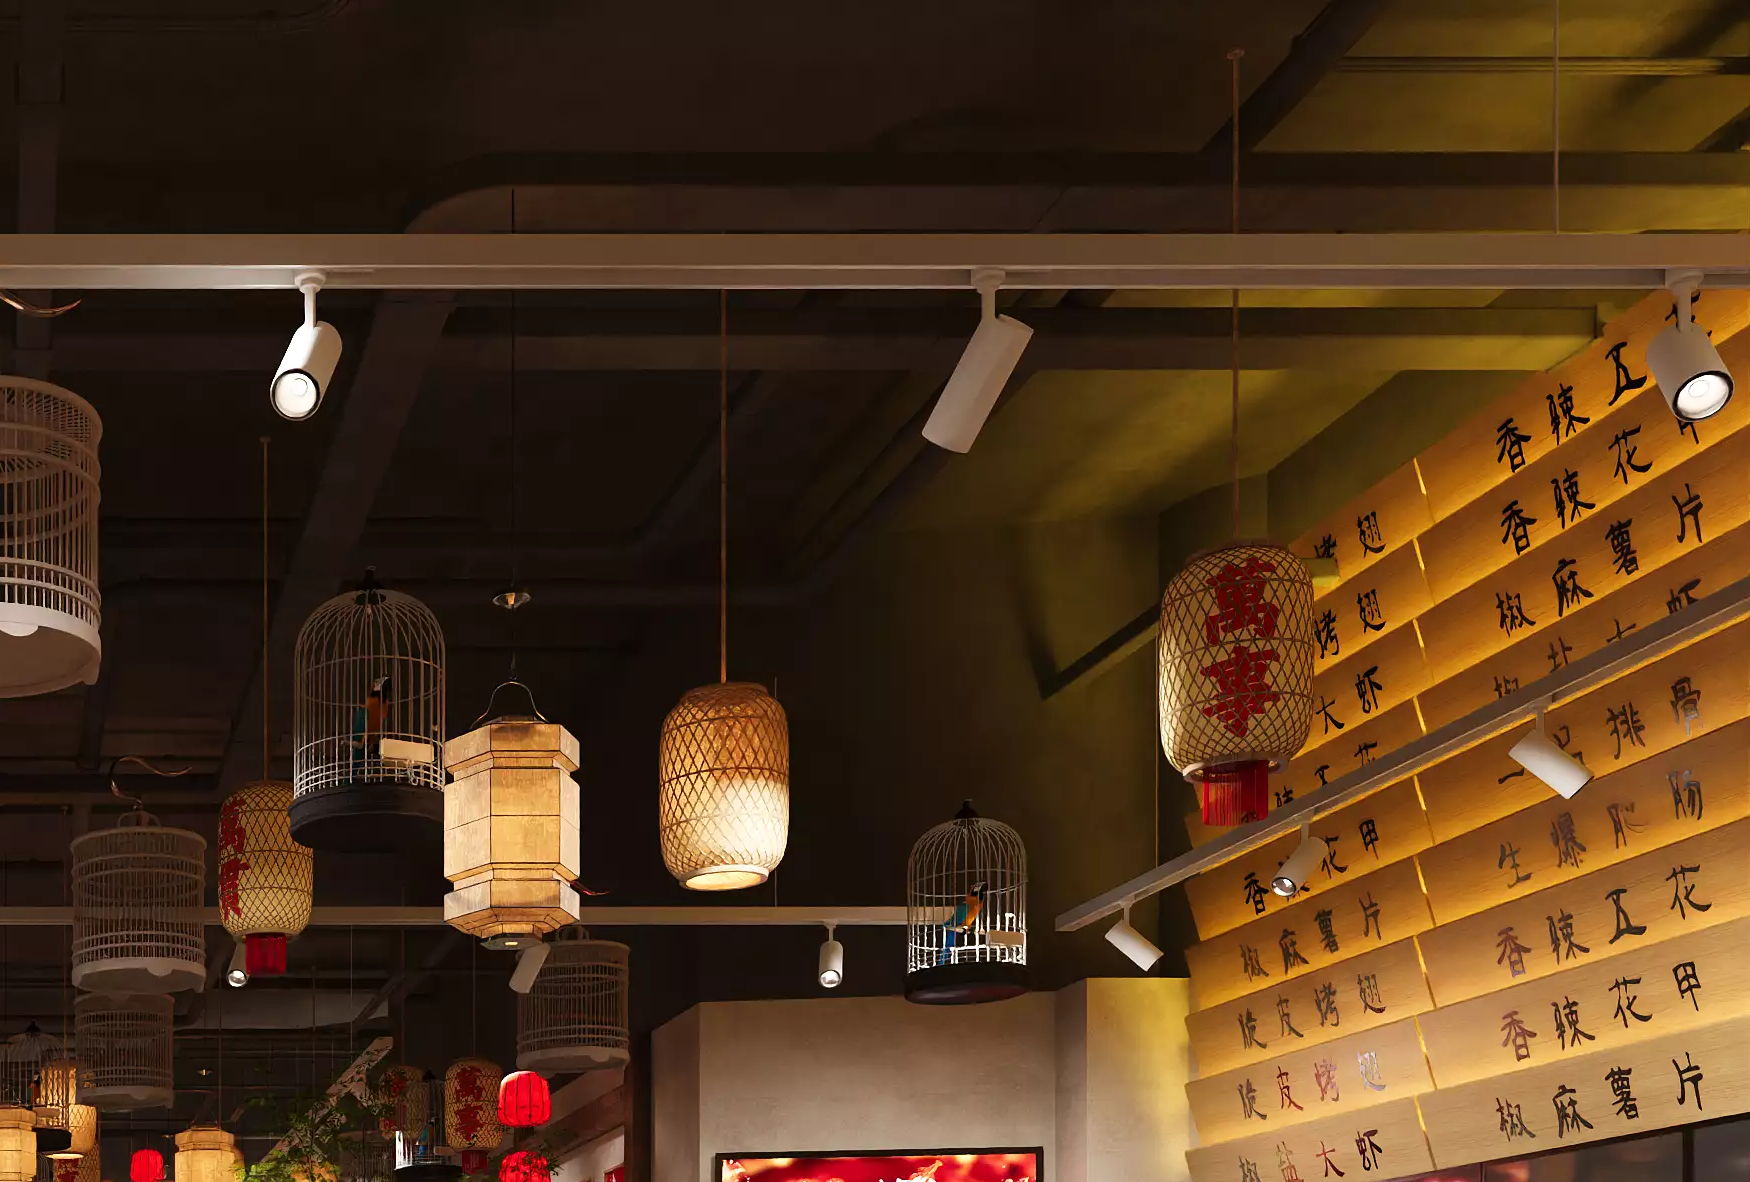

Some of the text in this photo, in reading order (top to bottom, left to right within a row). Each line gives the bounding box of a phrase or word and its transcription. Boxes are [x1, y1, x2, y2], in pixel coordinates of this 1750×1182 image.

[1496, 291, 1713, 474] 香辣五
[1500, 424, 1700, 555] 香辣花
[1495, 483, 1704, 638] 椒麻薯片
[1315, 665, 1383, 734] 大虾
[1243, 818, 1379, 916] 香花甲
[1239, 891, 1382, 983] 椒麻薯片
[1496, 864, 1712, 978] 香辣五花
[1500, 961, 1702, 1062] 香辣花甲
[1495, 1051, 1704, 1142] 椒麻薯片
